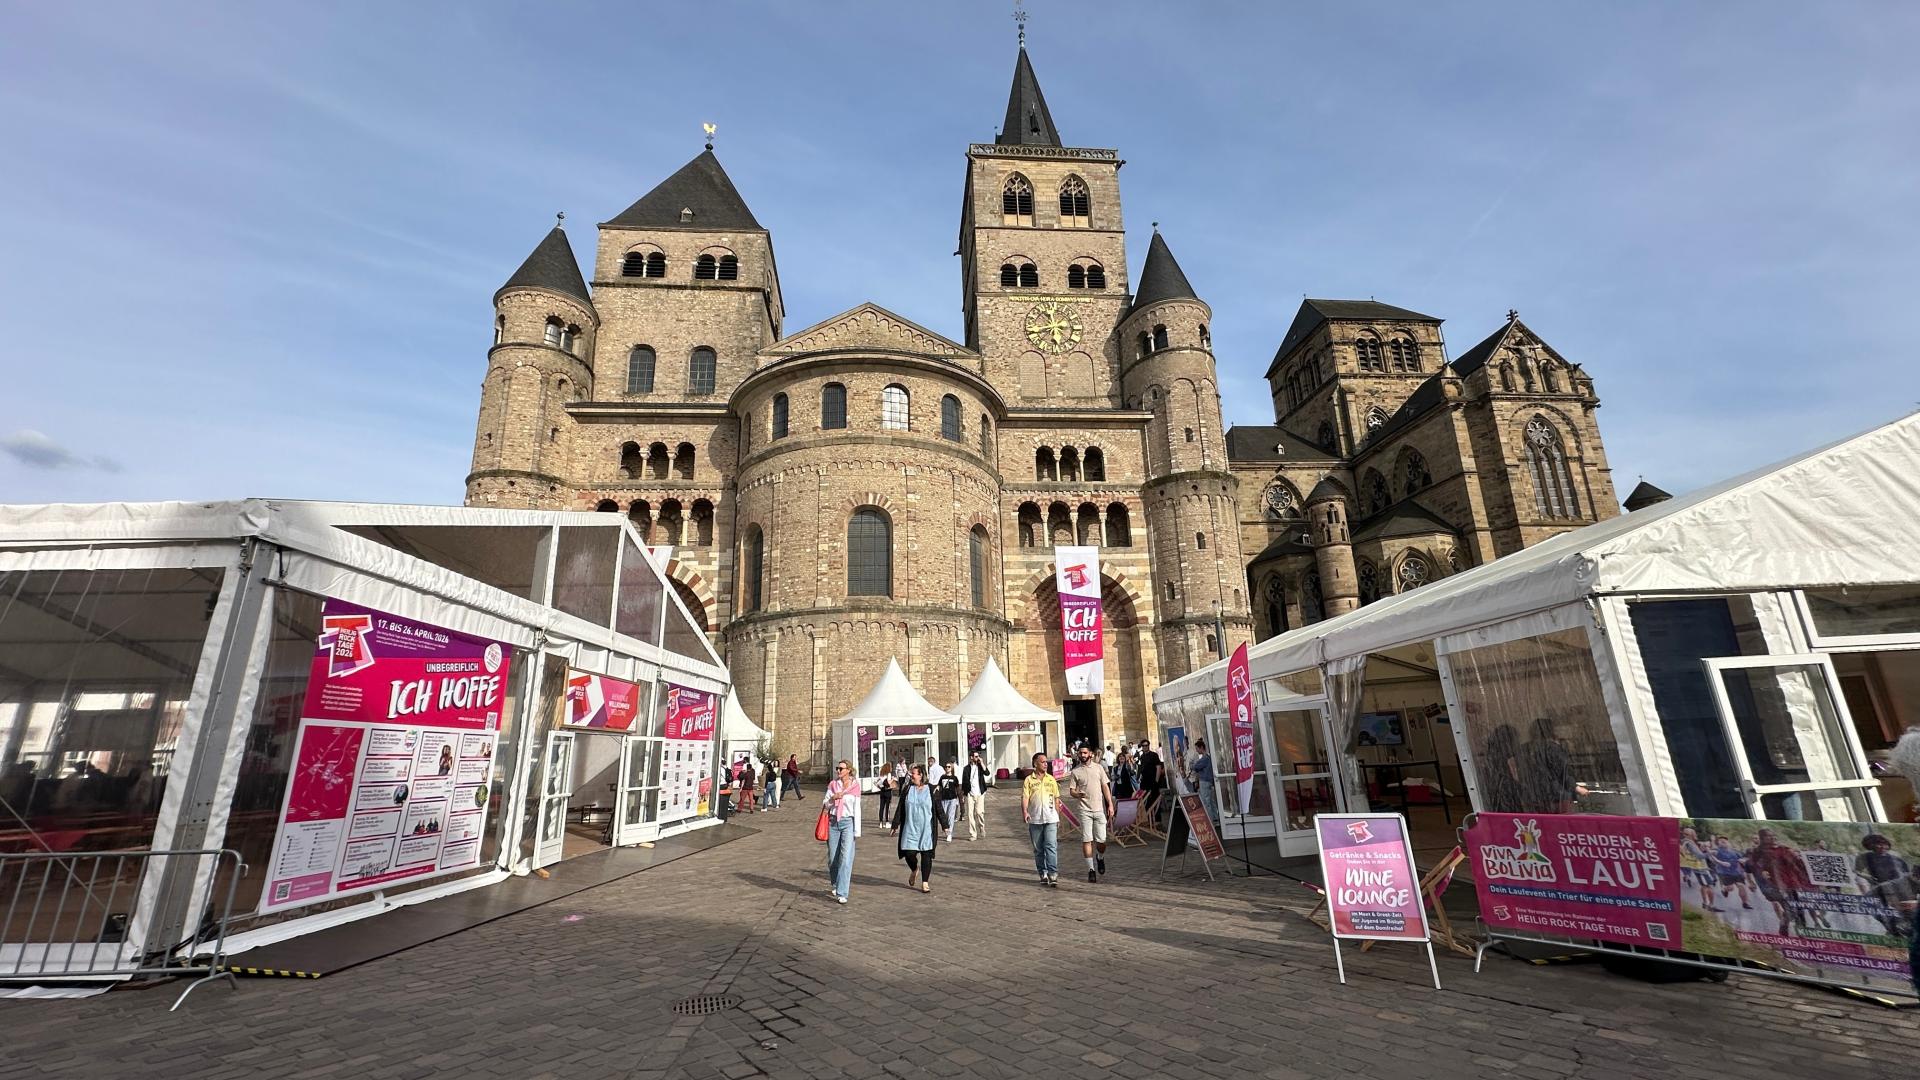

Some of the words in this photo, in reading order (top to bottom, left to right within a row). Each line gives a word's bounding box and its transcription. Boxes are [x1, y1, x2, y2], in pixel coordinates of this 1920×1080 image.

[1064, 607, 1098, 629] ICH
[338, 634, 355, 642] ROCK
[378, 619, 388, 630] 17.
[390, 622, 403, 632] BIS
[403, 626, 413, 635] 26.
[414, 628, 434, 640] APRIL
[434, 634, 449, 644] 2026
[336, 648, 353, 657] 2026
[337, 640, 355, 649] TAGE
[426, 663, 479, 672] UNBEGREIFLICH
[387, 679, 433, 719] ICH
[439, 675, 500, 712] HOFFE
[681, 717, 693, 737] ICH
[694, 712, 713, 731] HOFFE
[1557, 833, 1639, 847] SPENDEN-
[1644, 837, 1656, 849] &
[1561, 846, 1660, 863] INKLUSIONS
[1345, 868, 1394, 887] WINE
[1563, 859, 1664, 890] LAUF
[1338, 887, 1409, 907] LOUNGE
[1490, 885, 1507, 894] Dein
[1508, 887, 1547, 899] Laufevent
[1548, 890, 1556, 899] in
[1557, 892, 1577, 902] Trier
[1579, 894, 1593, 903] für
[1595, 896, 1614, 905] eine
[1616, 898, 1636, 908] gute
[1638, 899, 1672, 911] Sache!
[1797, 891, 1825, 901] MEHR
[1829, 893, 1858, 903] INFOS
[1862, 896, 1880, 905] AUF
[1517, 914, 1548, 925] HEILIG
[1550, 918, 1577, 929] ROCK
[1579, 921, 1605, 933] TAGE
[1608, 925, 1640, 937] TRIER
[1737, 933, 1827, 949] INKLUSIONSLAUF
[1797, 929, 1869, 942] KINDERLAUF
[1786, 950, 1902, 970] ERWACHSENENLAUF
